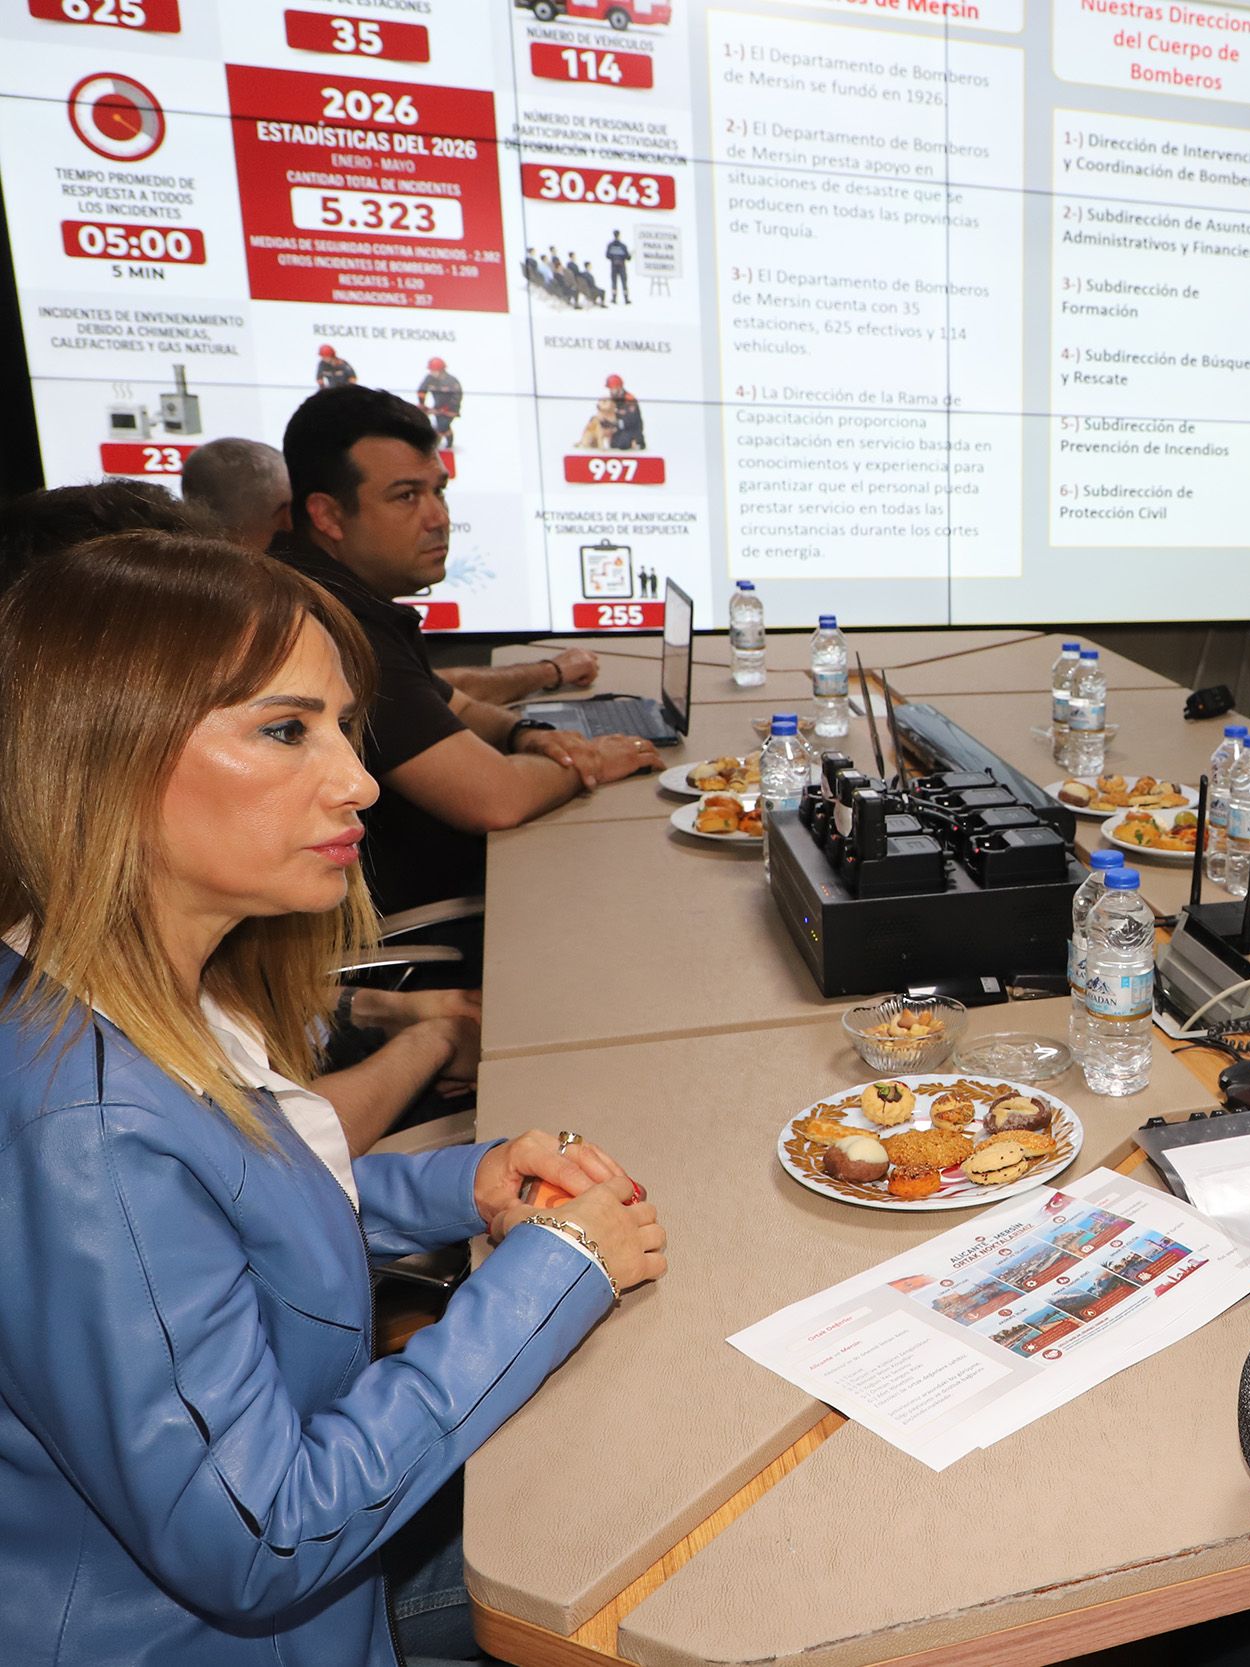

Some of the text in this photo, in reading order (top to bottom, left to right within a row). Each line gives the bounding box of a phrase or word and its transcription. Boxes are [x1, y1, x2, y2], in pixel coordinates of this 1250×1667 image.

[62, 0, 146, 27] 625
[1080, 0, 1164, 21] Nuestras
[330, 18, 383, 55] 35
[1114, 30, 1240, 63] del Cuerpo de
[561, 49, 623, 83] 114
[770, 48, 884, 76] Departamento
[724, 68, 743, 83] de
[749, 71, 805, 92] Mersin
[1130, 63, 1223, 91] Bomberos
[321, 87, 419, 125] 2026
[257, 120, 478, 160] ESTADÍSTICAS DEL 2026
[772, 123, 885, 149] Departamento
[1088, 133, 1157, 154] Dirección
[1161, 143, 1179, 156] de
[332, 154, 416, 173] ENERO MAYO
[727, 143, 746, 159] de
[752, 146, 807, 165] Mersin
[55, 167, 195, 189] TIEMPO PROMEDIO DE
[1063, 159, 1071, 172] y
[1076, 158, 1173, 180] Coordinación
[1178, 167, 1195, 181] de
[287, 170, 461, 196] CANTIDAD TOTAL DE INCIDENTES
[538, 168, 660, 207] 30.643
[62, 184, 136, 200] RESPUESTA
[152, 191, 193, 205] TODOS
[78, 201, 182, 220] LOS INCIDENTES
[320, 197, 435, 232] 5.323
[1087, 207, 1180, 229] Subdirección
[1184, 216, 1202, 230] de
[78, 225, 192, 260] 05:00
[1062, 231, 1176, 252] Administrativos
[1181, 243, 1189, 256] y
[113, 265, 165, 280] 5 MIN
[1086, 278, 1178, 298] Subdirección
[1182, 285, 1199, 299] de
[38, 306, 244, 327] INCIDENTES DE ENVENENAMIENTO
[1062, 301, 1138, 318] Formación
[313, 324, 456, 342] RESCATE DE PERSONAS
[544, 336, 671, 354] RESCATE DE ANIMALES
[1086, 349, 1176, 367] Subdirección
[1181, 354, 1197, 367] de
[1061, 371, 1128, 386] y Rescate
[1084, 417, 1175, 434] Subdirección
[1178, 420, 1195, 434] de
[1060, 440, 1229, 457] Prevención de Incendios
[588, 458, 638, 481] 997
[1083, 484, 1172, 499] Subdirección
[1177, 485, 1194, 499] de
[535, 510, 603, 521] ACTIVIDADES
[607, 512, 618, 521] DE
[1060, 506, 1167, 521] Protección Civil
[555, 525, 614, 534] SIMULACRO
[617, 525, 629, 534] DE
[633, 526, 689, 535] RESPUESTA
[598, 605, 644, 626] 255
